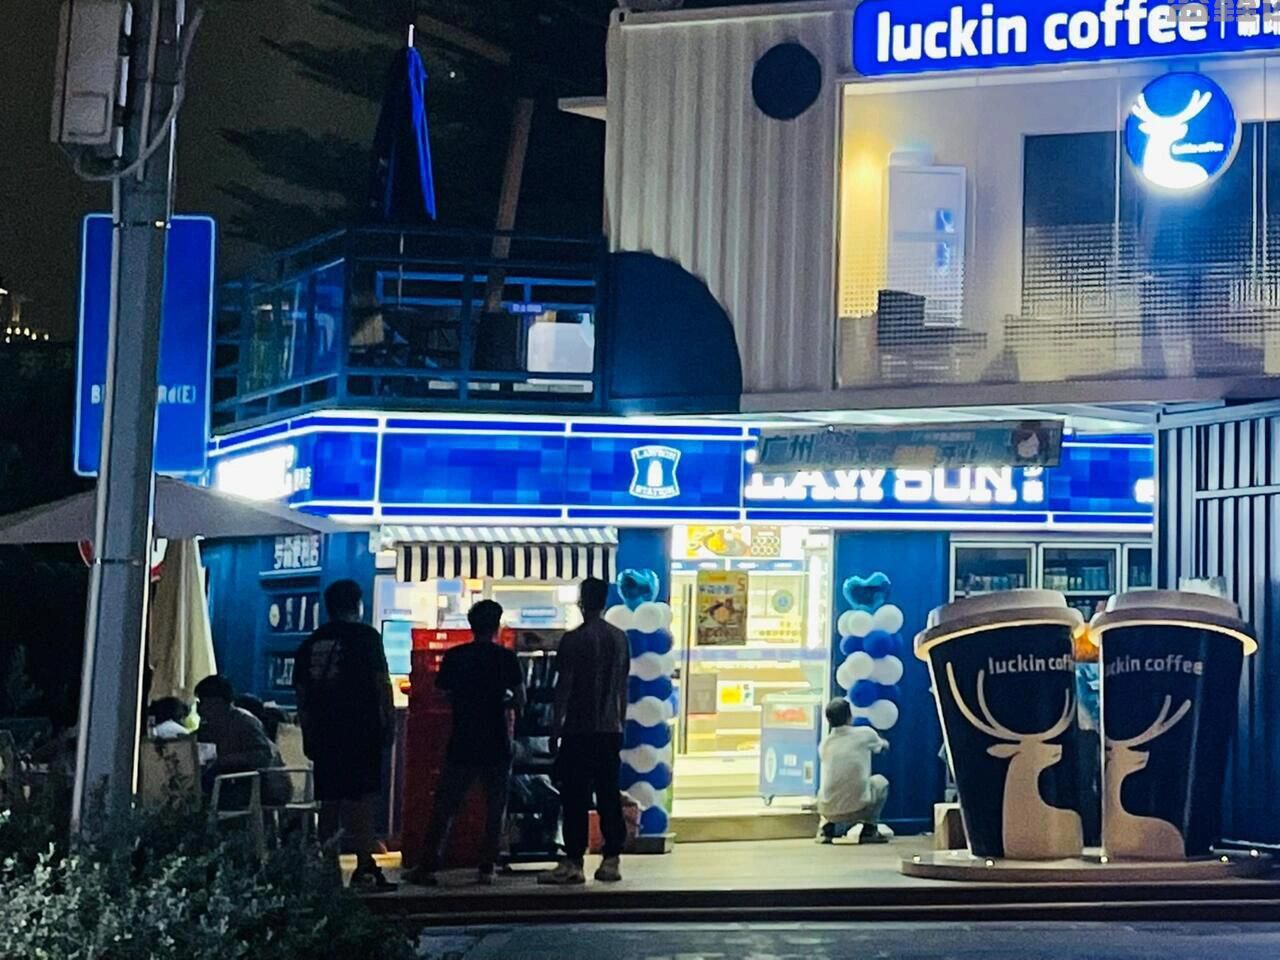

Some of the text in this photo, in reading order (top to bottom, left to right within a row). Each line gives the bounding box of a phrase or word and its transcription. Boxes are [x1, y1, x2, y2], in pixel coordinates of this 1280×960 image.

[877, 3, 1027, 62] luckin
[988, 653, 1046, 675] luckin
[1144, 654, 1203, 675] coffee
